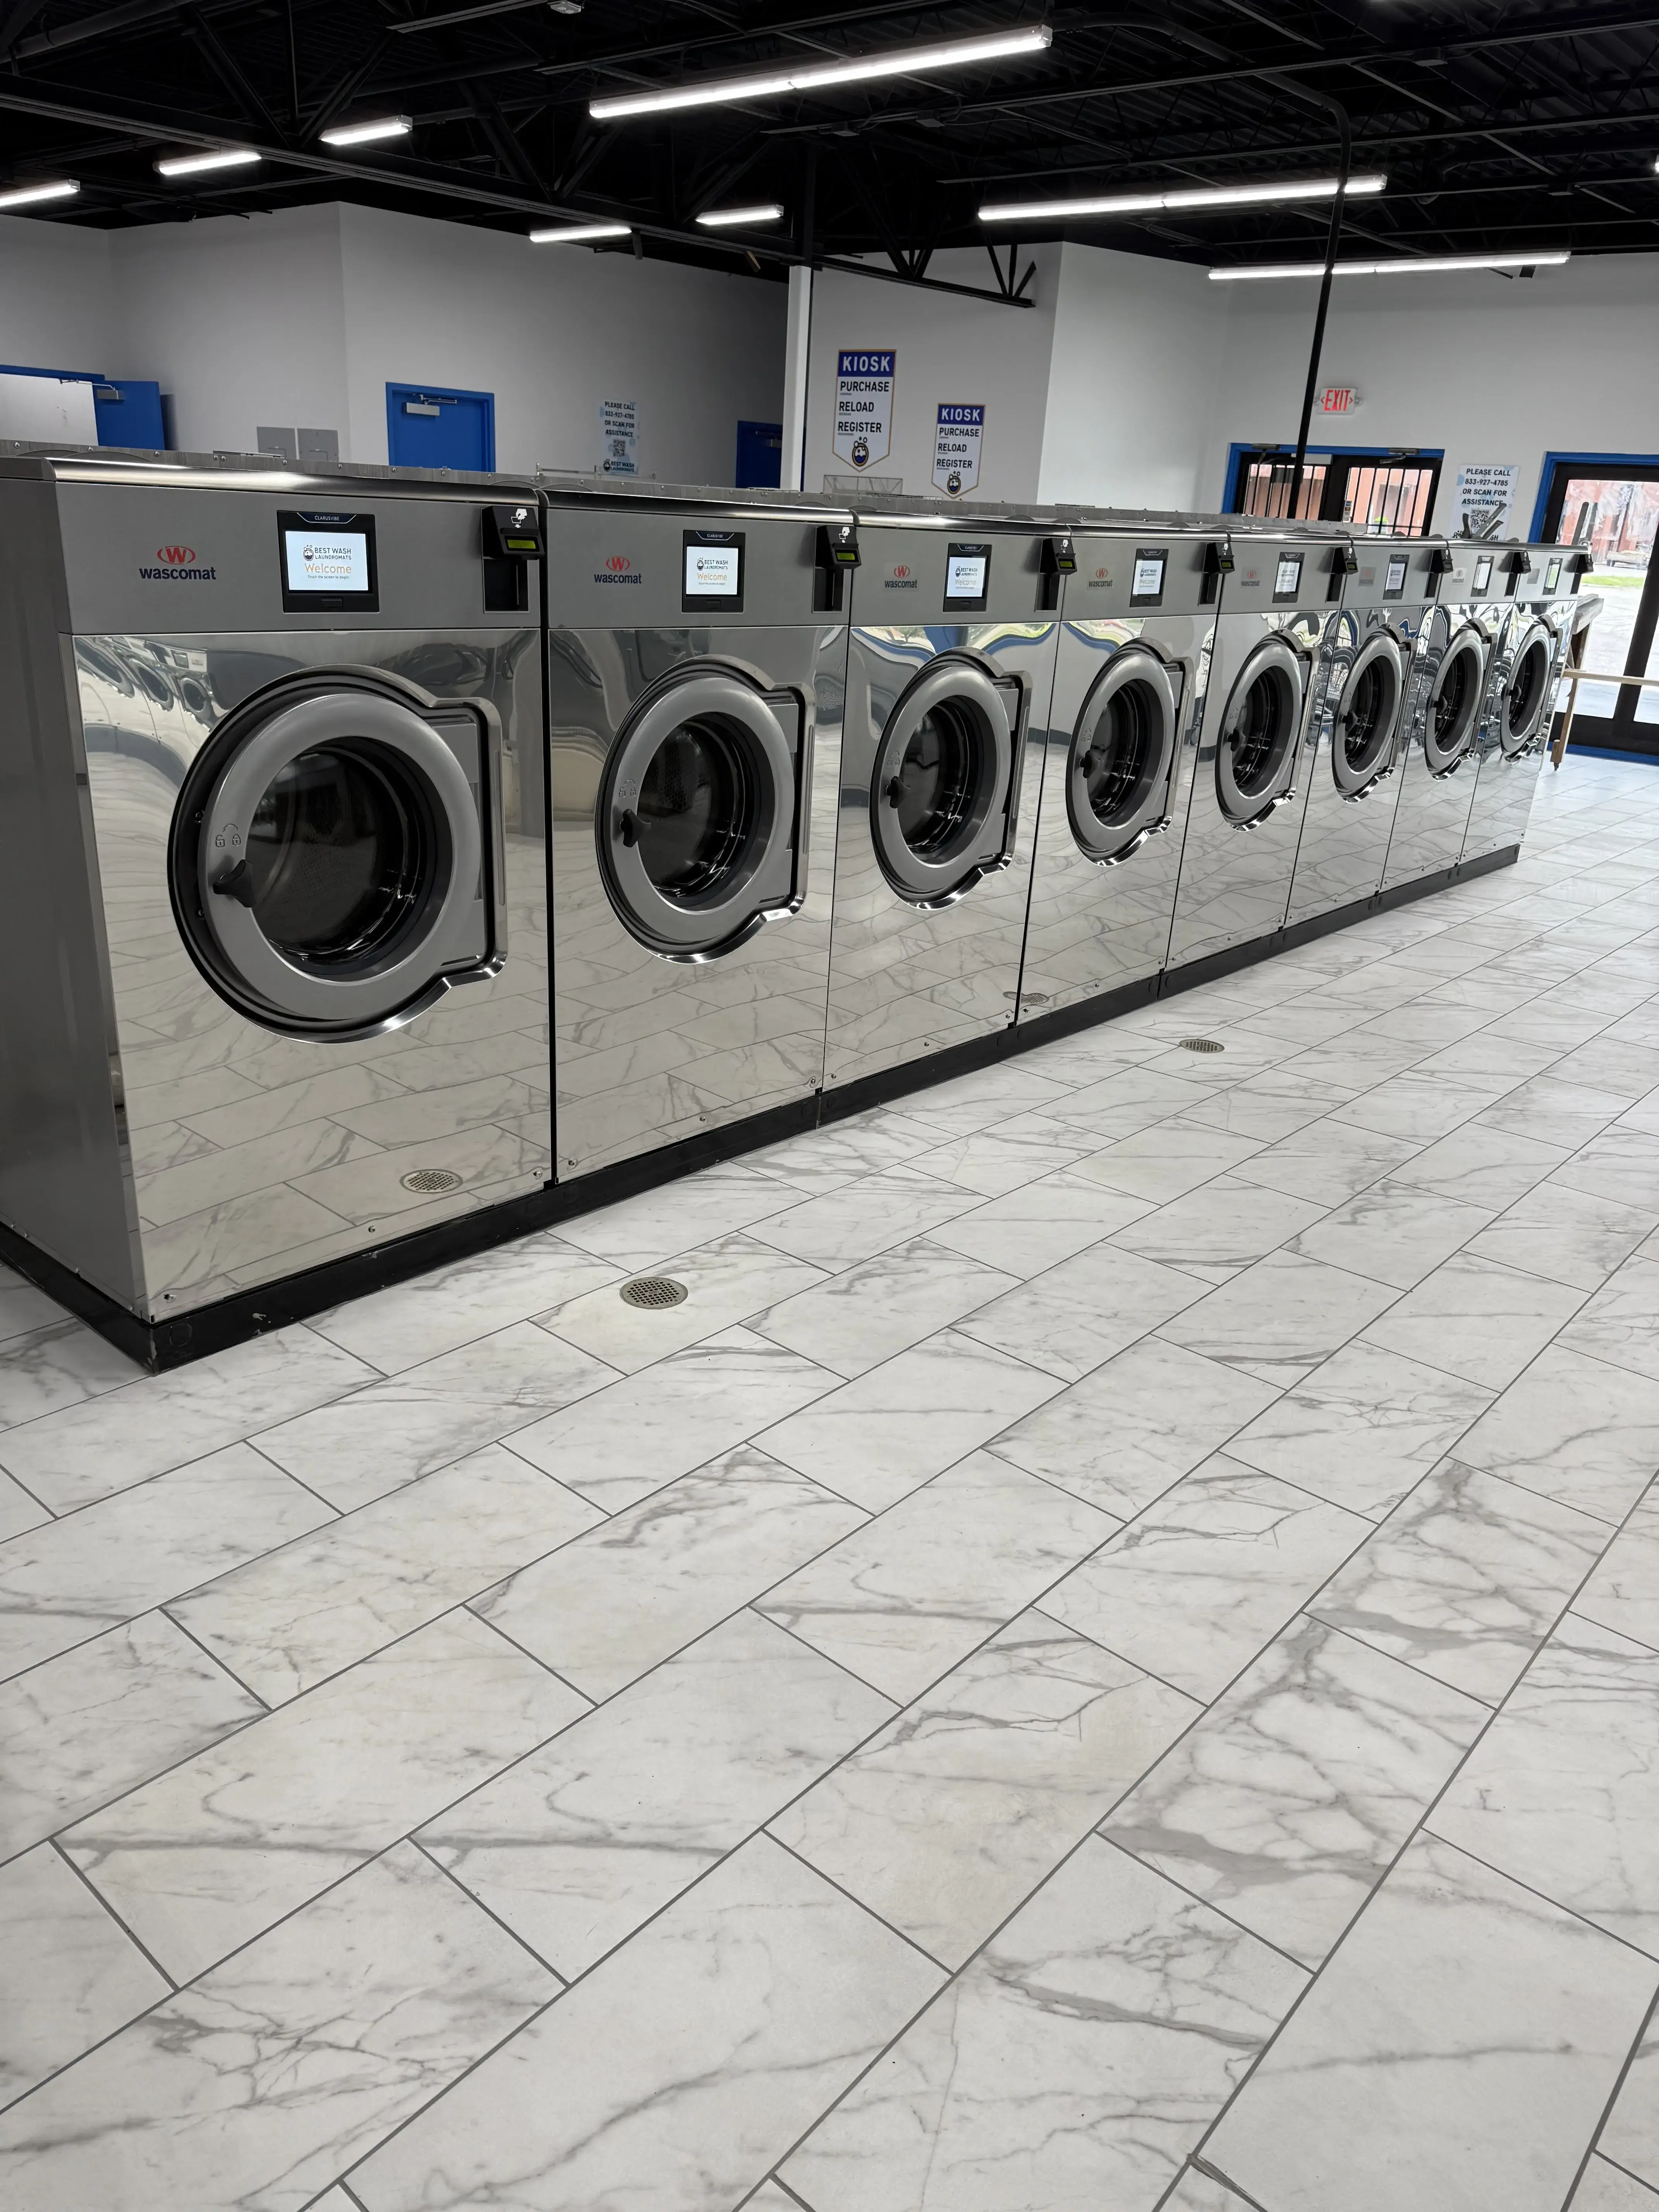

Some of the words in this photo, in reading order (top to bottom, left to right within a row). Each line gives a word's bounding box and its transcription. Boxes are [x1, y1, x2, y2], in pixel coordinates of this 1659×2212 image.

[843, 356, 890, 372] KIOSK
[840, 381, 890, 392] PURCHASE
[605, 401, 622, 409] PLEASE
[1324, 390, 1351, 411] EXIT
[839, 401, 874, 412] RELOAD
[941, 408, 980, 421] KIOSK
[838, 421, 882, 433] REGISTER
[939, 427, 980, 437] PURCHASE
[605, 429, 633, 438] ASSISTANCE
[938, 443, 967, 452] RELOAD
[936, 459, 972, 469] REGISTER
[1465, 478, 1508, 486] 833-927-4785
[139, 567, 216, 580] wascomat
[304, 563, 352, 574] Welcome
[594, 573, 642, 584] wascomat
[697, 572, 727, 581] Welcome
[884, 579, 917, 588] wascomat
